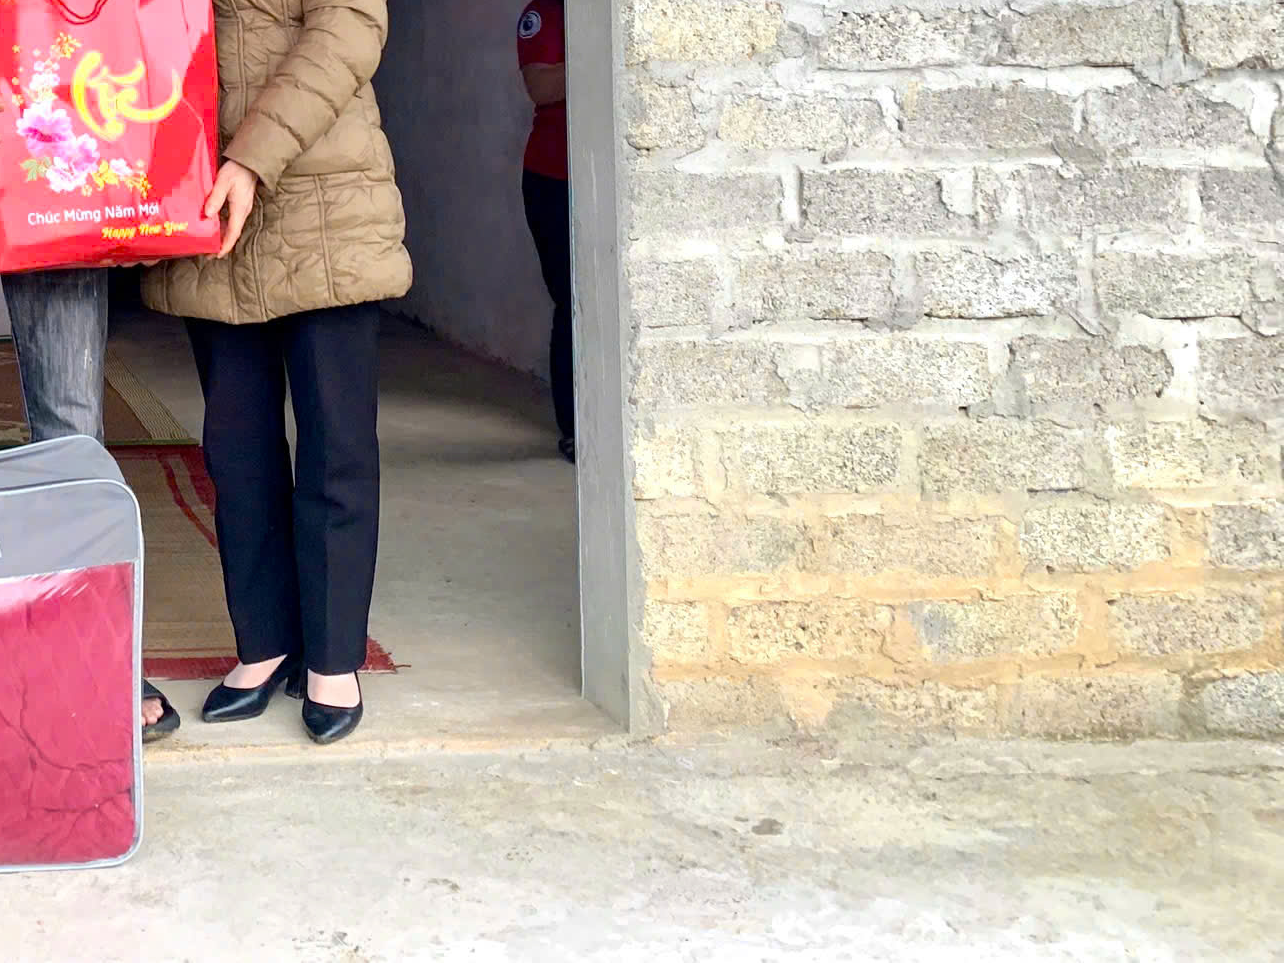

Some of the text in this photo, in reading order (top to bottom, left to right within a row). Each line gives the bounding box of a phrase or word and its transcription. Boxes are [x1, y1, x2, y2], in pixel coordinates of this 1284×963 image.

[27, 202, 159, 225] Chúc Mừng Năm Mới
